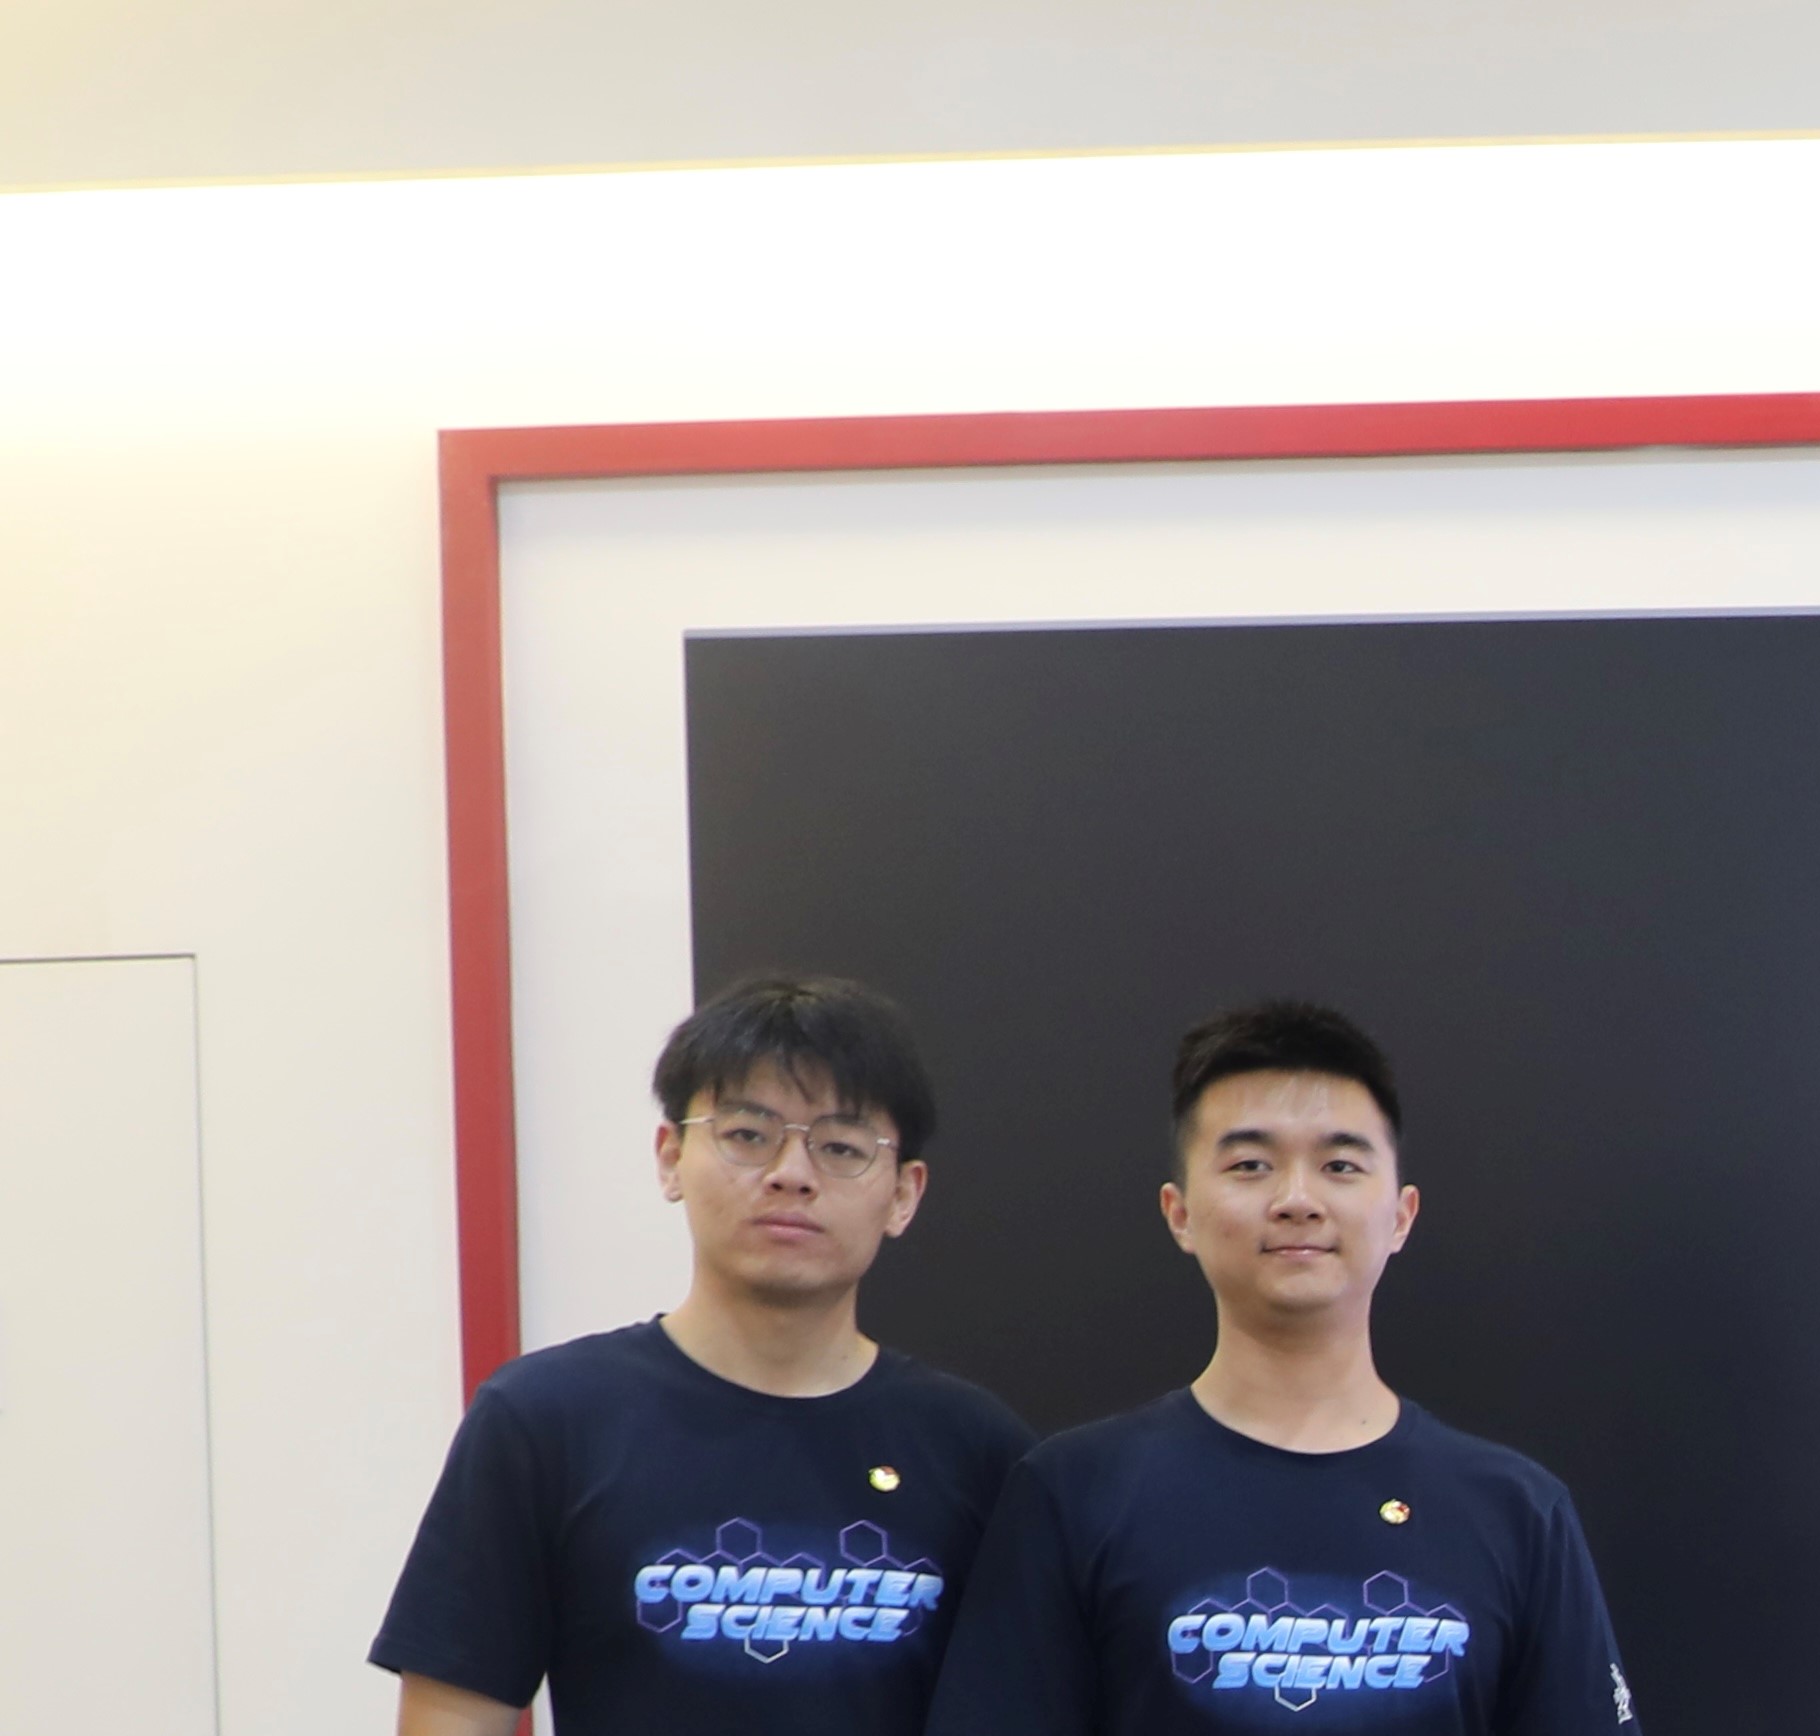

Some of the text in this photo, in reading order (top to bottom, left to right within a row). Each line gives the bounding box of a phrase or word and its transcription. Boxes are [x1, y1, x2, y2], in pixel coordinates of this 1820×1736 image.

[634, 1565, 944, 1611] COMPUTER
[681, 1603, 909, 1642] SCIENCE
[1168, 1613, 1470, 1657] COMPUTER
[1212, 1652, 1432, 1690] SCIENCE
